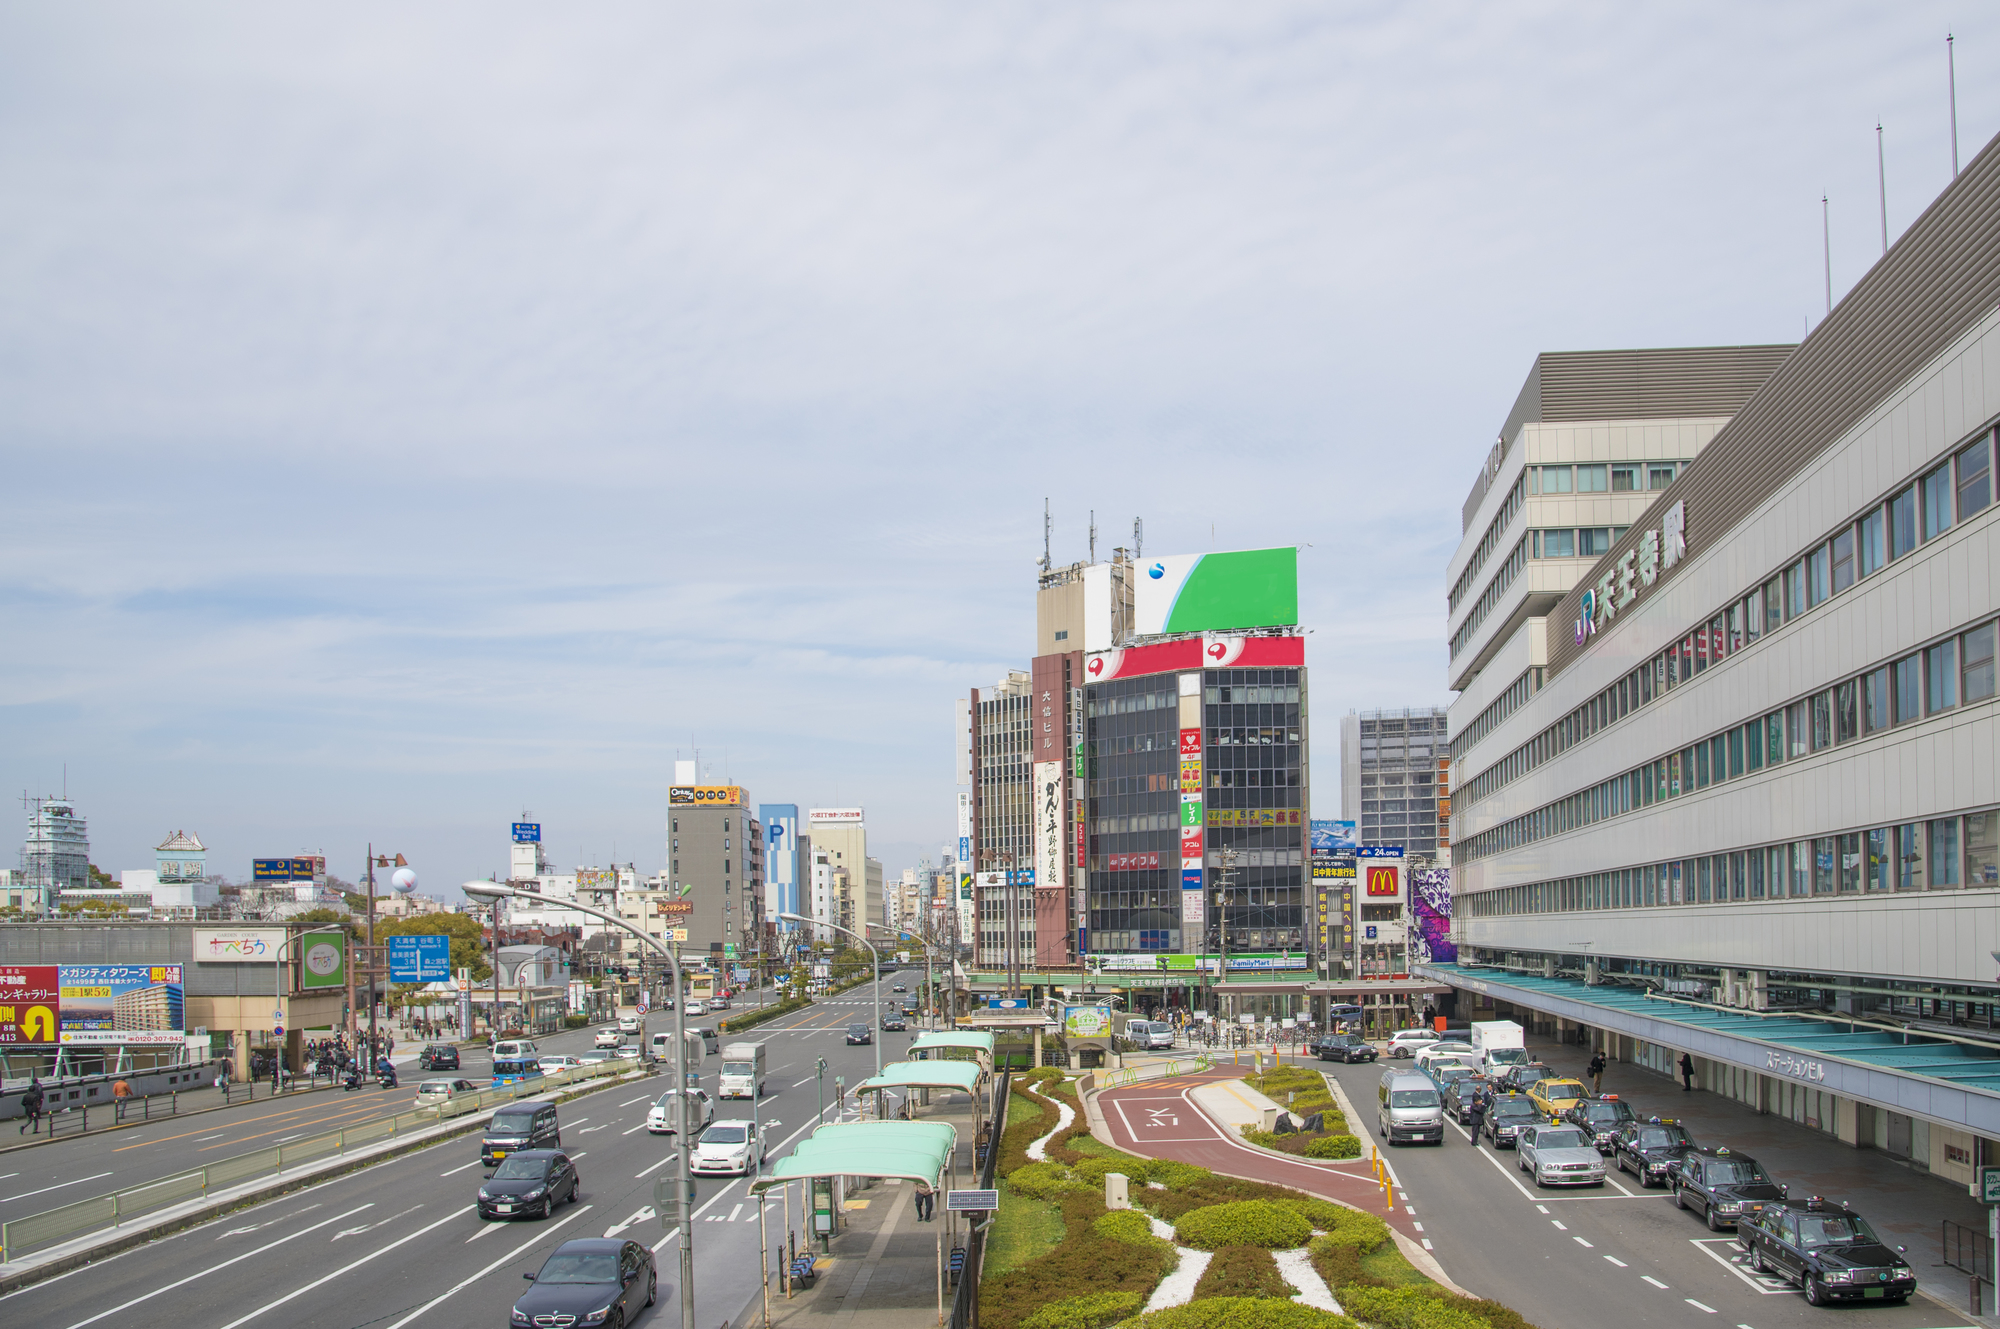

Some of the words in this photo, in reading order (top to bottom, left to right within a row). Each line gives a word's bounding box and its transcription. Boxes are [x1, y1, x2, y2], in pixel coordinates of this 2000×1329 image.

[1042, 690, 1052, 749] 大信ビル
[1182, 769, 1200, 781] 麻雀
[1276, 810, 1299, 824] 麻雀
[770, 824, 784, 844] P
[1120, 856, 1158, 867] アイフル
[1313, 868, 1356, 877] 日中青年旅行社
[658, 904, 690, 912] びっくりドンキー
[664, 930, 674, 940] P
[1232, 958, 1270, 968] FamilyMart
[60, 968, 148, 978] メガシティタワーズ
[152, 967, 166, 982] 即
[80, 987, 110, 997] 1駅5分
[1766, 1051, 1825, 1082] ステーションビル
